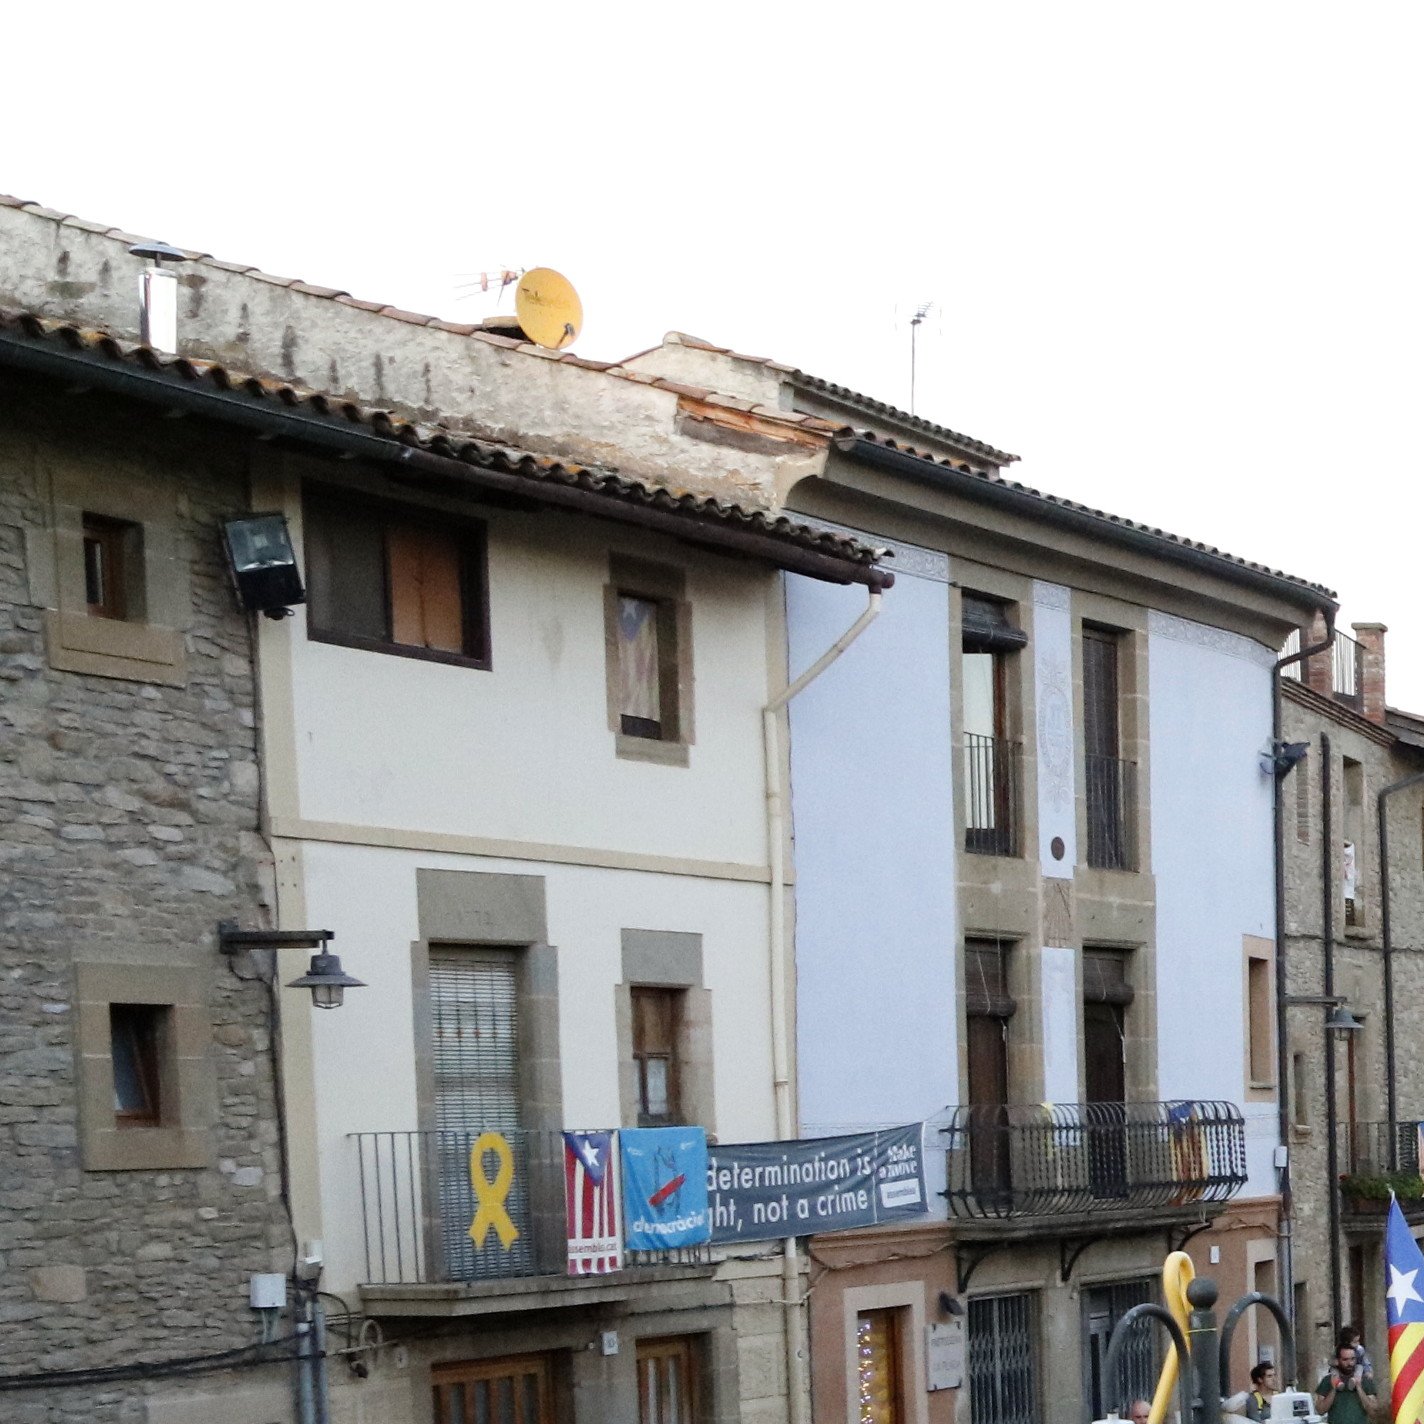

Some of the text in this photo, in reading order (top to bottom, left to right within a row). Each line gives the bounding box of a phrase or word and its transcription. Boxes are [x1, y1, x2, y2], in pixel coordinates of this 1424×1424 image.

[707, 1149, 871, 1191] determination is
[753, 1194, 788, 1224] not
[797, 1201, 809, 1219] a
[817, 1185, 868, 1216] crime
